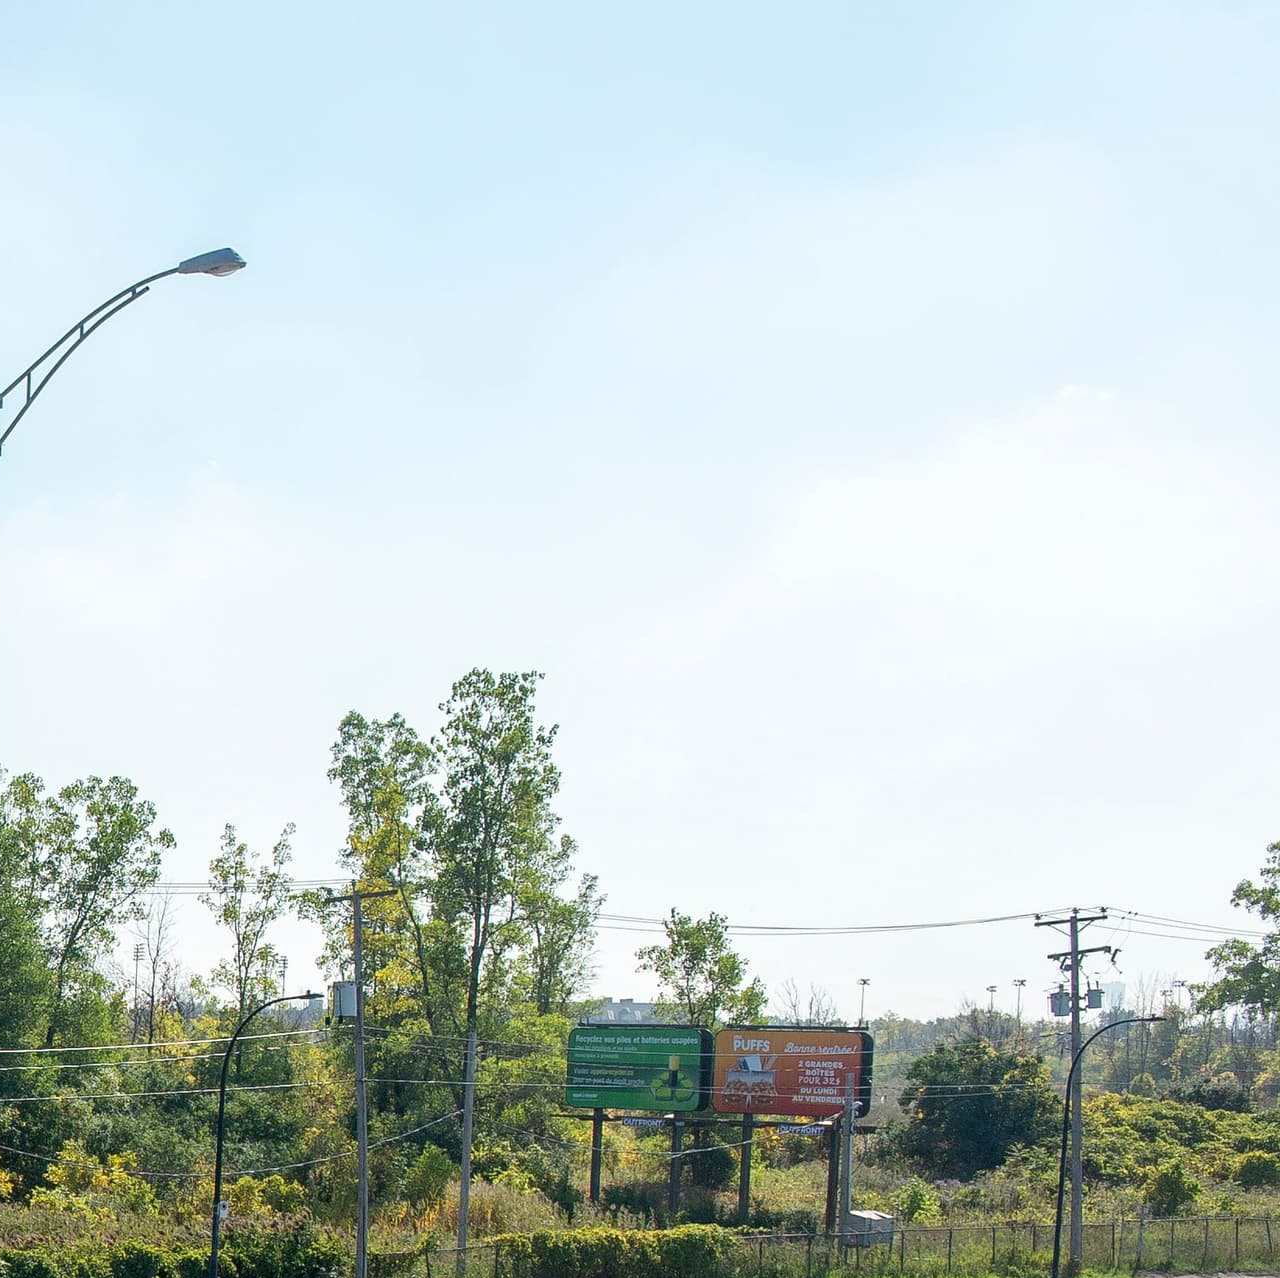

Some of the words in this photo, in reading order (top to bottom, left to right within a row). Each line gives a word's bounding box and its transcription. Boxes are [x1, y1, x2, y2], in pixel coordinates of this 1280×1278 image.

[616, 1035, 632, 1045] piles
[633, 1036, 640, 1044] et
[641, 1035, 670, 1044] batteries
[734, 1039, 770, 1052] PUFFS
[784, 1042, 817, 1053] Bonne
[798, 1060, 804, 1068] 2
[804, 1060, 844, 1068] GRANDES
[798, 1076, 821, 1085] POUR
[813, 1087, 837, 1096] LUNDI
